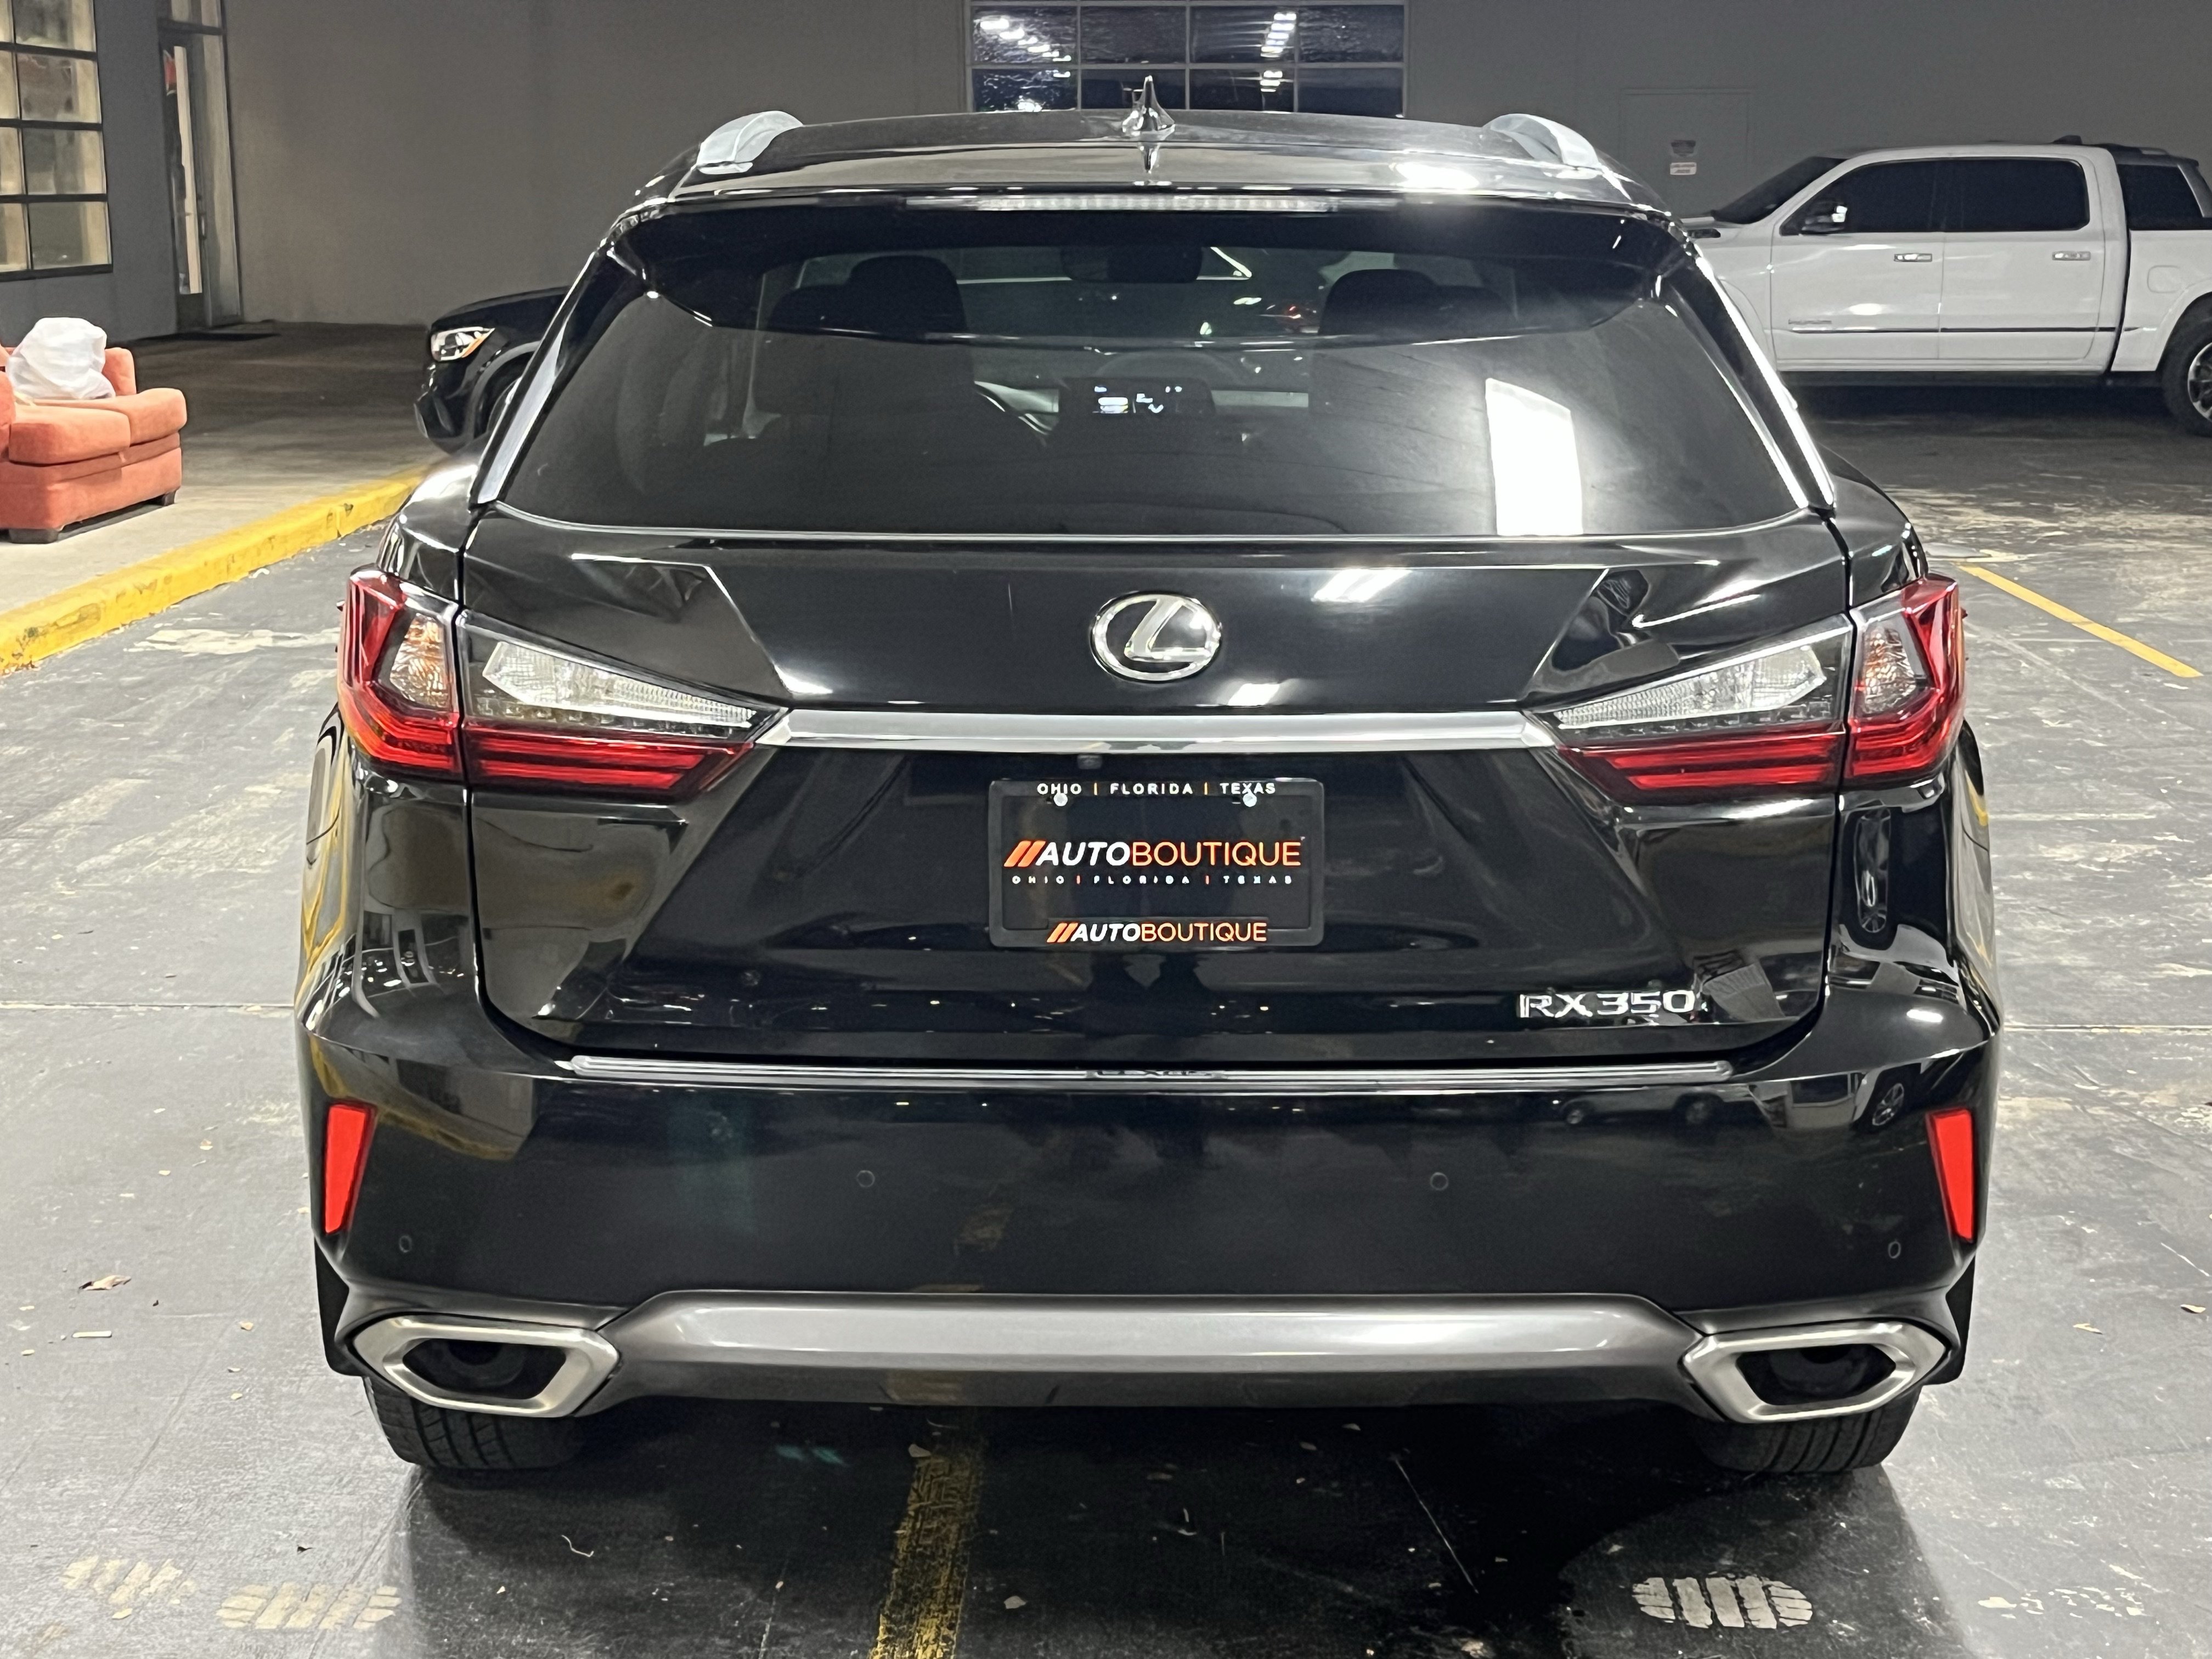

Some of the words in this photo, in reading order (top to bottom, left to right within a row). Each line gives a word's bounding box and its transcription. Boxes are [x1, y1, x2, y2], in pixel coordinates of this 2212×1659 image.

[1036, 782, 1082, 795] OHIO
[1109, 782, 1194, 795] FLORIDA
[1219, 782, 1276, 795] TEXAS
[1035, 841, 1302, 866] AUTOBOUTIQUE
[1012, 875, 1065, 884] OHIO
[1070, 922, 1267, 942] AUTOBOUTIQUE
